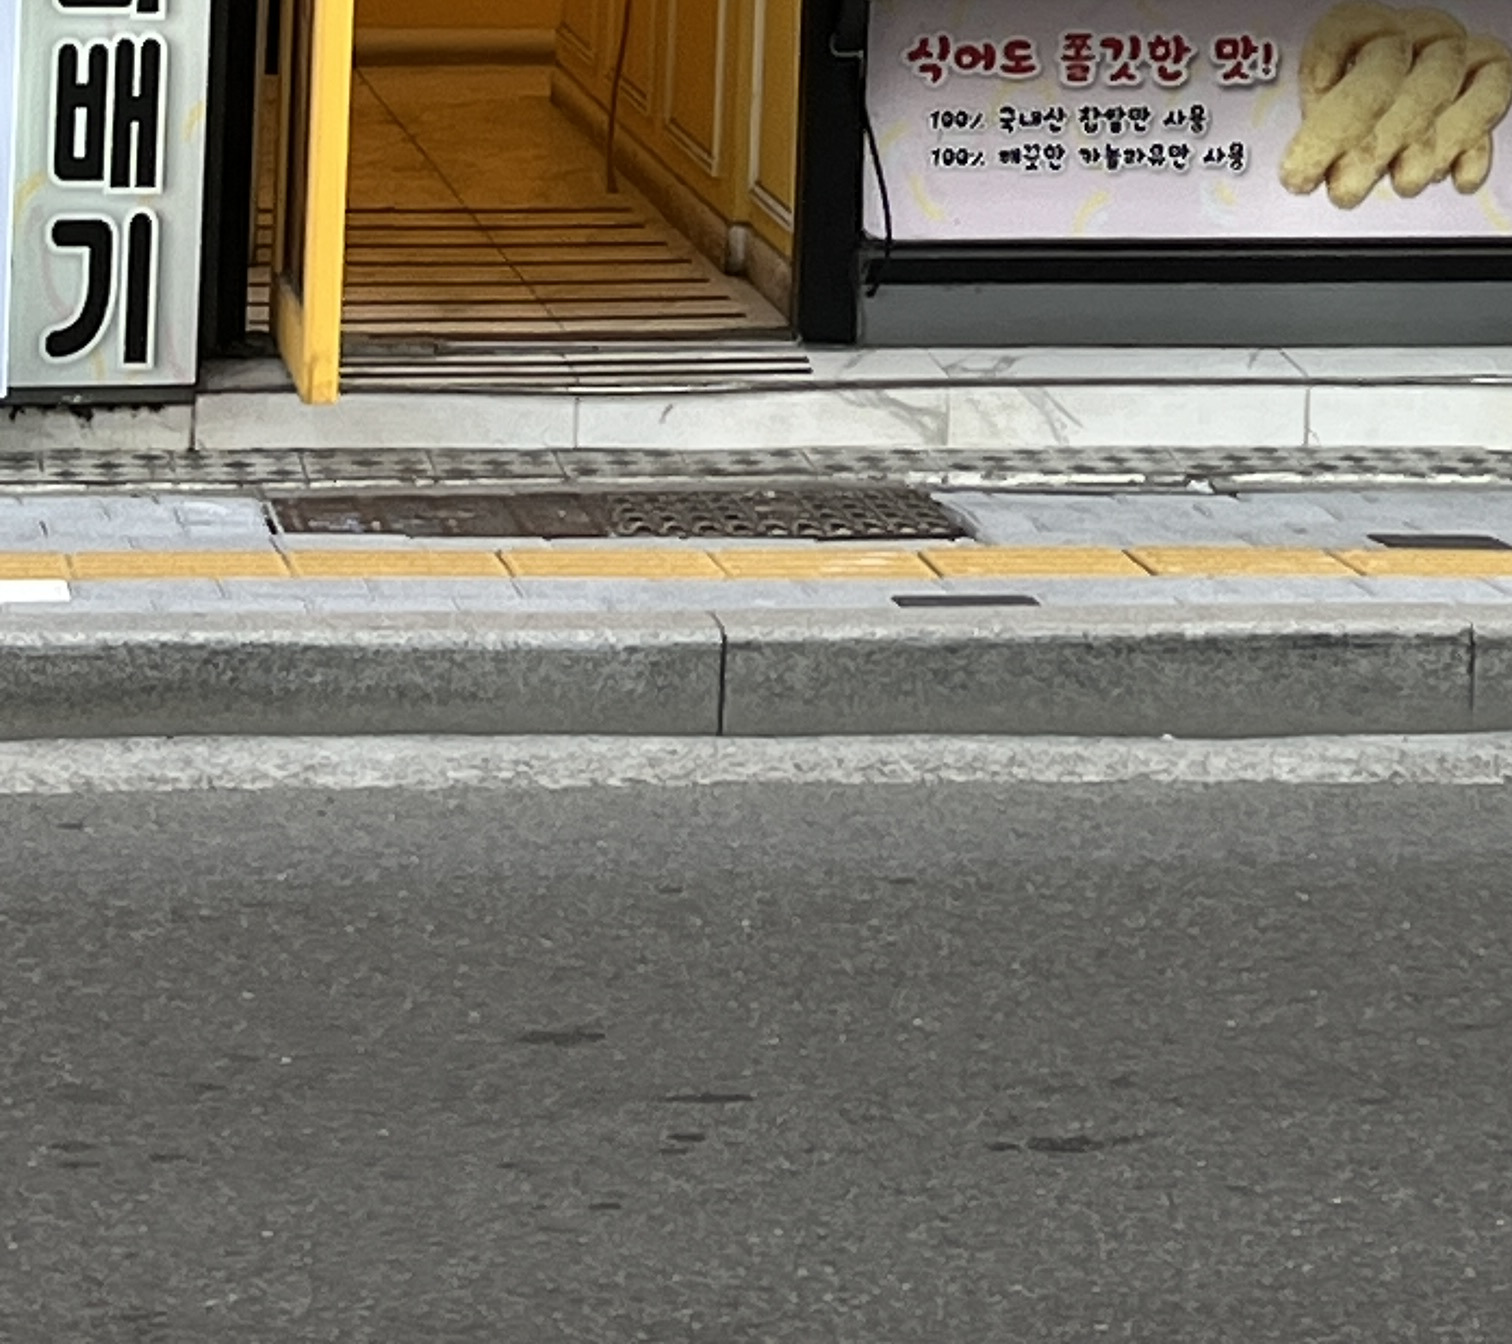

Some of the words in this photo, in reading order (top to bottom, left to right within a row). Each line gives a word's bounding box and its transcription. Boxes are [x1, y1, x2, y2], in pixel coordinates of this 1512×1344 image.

[906, 33, 1037, 84] 식어도
[1213, 34, 1275, 82] 맛!
[930, 110, 985, 130] 100%
[999, 106, 1066, 133] 국내산
[1162, 104, 1206, 133] 사용
[931, 147, 985, 167] 100%
[1202, 141, 1245, 171] 사용
